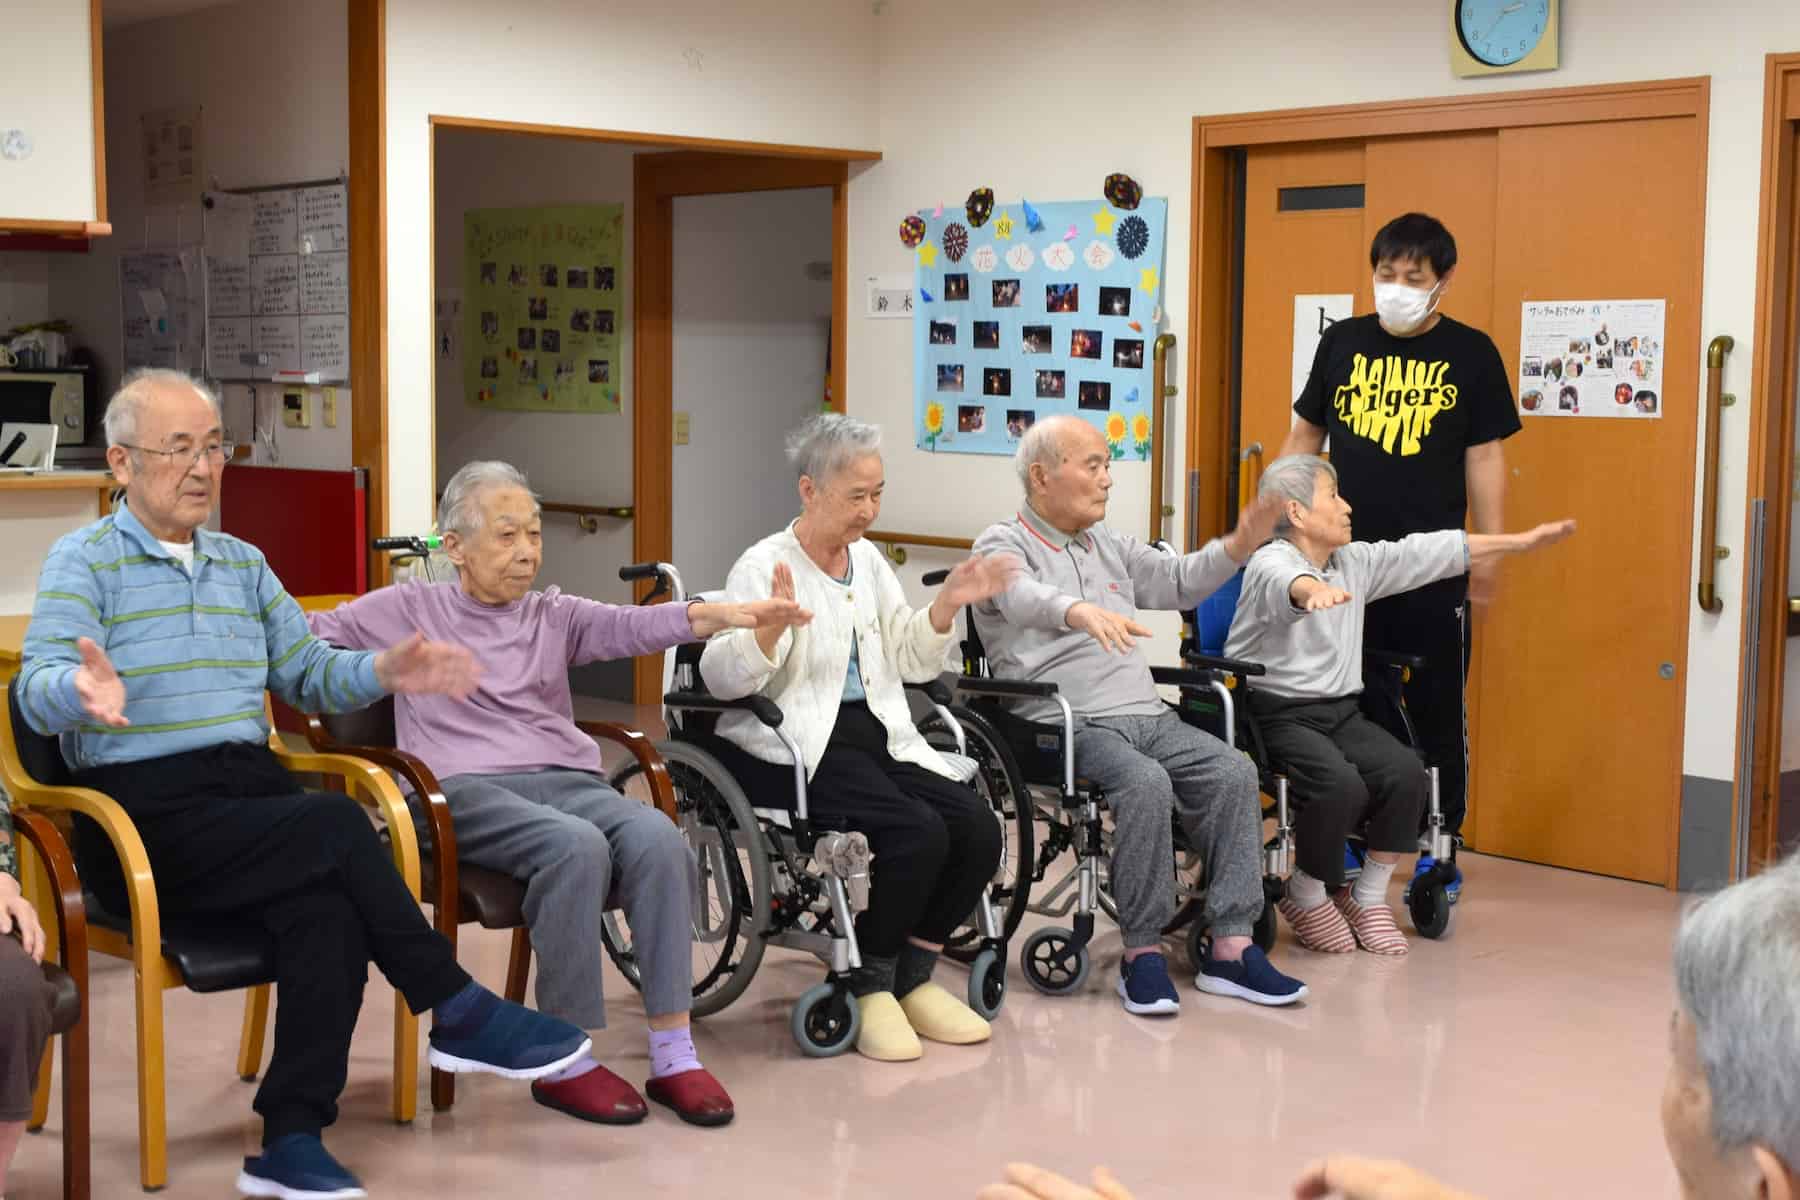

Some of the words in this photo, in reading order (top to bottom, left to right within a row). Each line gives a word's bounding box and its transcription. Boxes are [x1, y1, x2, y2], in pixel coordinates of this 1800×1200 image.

[1472, 30, 1479, 41] 8
[1520, 40, 1527, 50] 5
[1502, 48, 1510, 58] 6
[975, 244, 1108, 269] 花火大会
[1335, 382, 1458, 419] Tigers
